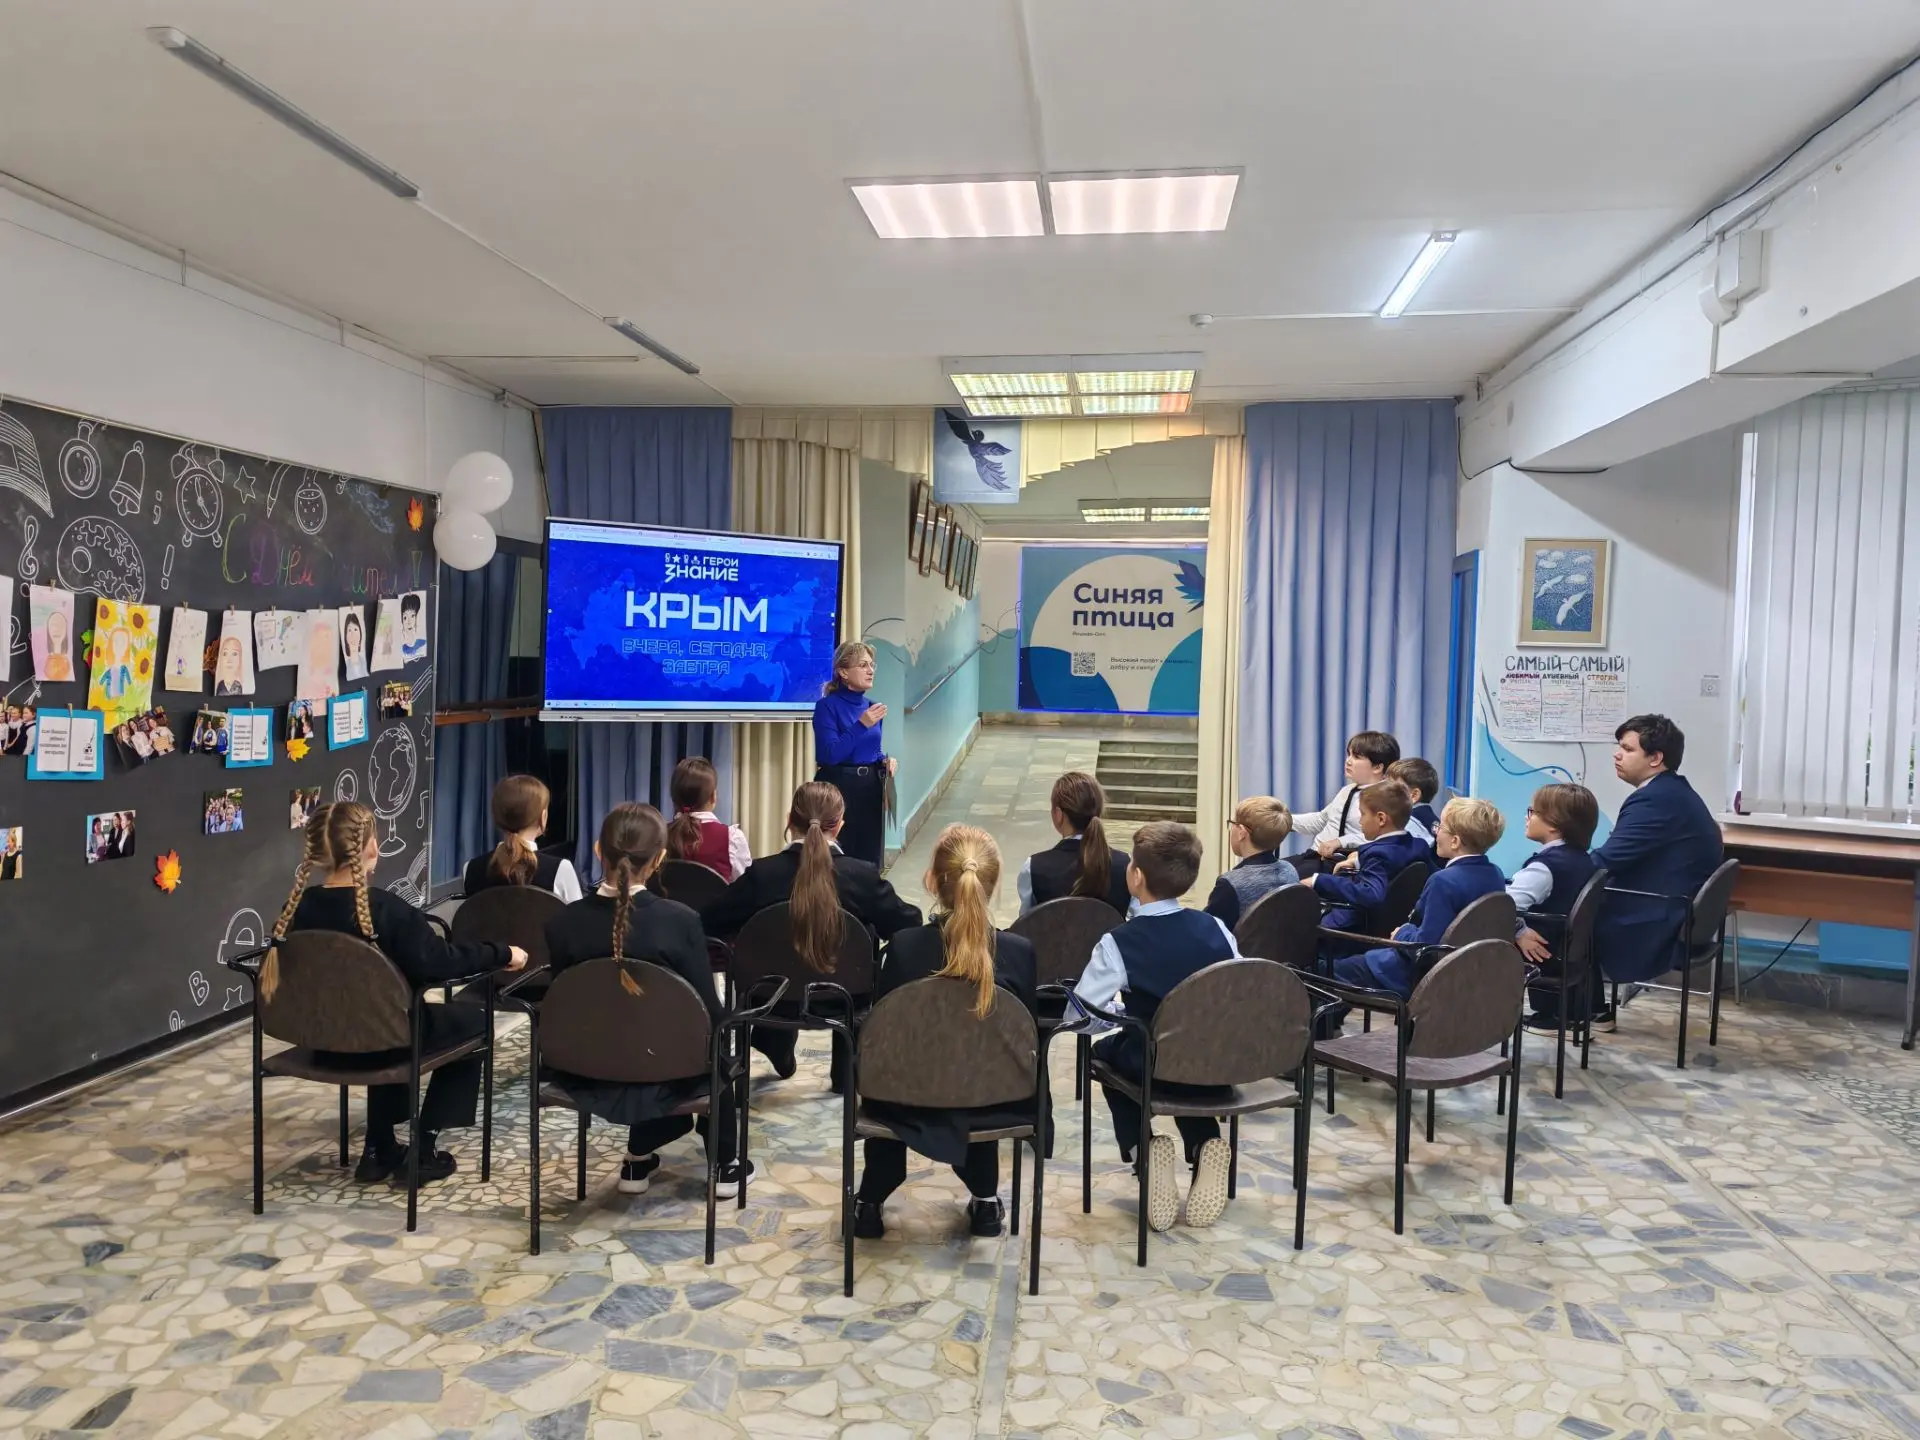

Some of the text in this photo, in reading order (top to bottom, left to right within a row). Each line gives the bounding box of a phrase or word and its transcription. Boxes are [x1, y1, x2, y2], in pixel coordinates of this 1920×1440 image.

[703, 556, 739, 568] ГЕРОИ
[1073, 582, 1164, 604] Синяя
[625, 590, 768, 633] КРЫМ
[1072, 610, 1174, 630] птица
[622, 638, 769, 659] ВЧЕРА, СЕГОДНЯ,
[662, 658, 731, 675] ЗАВТРА
[1505, 655, 1625, 672] САМЫЙ-САМЫЙ
[1542, 672, 1580, 680] ДУШЕВНЫЙ
